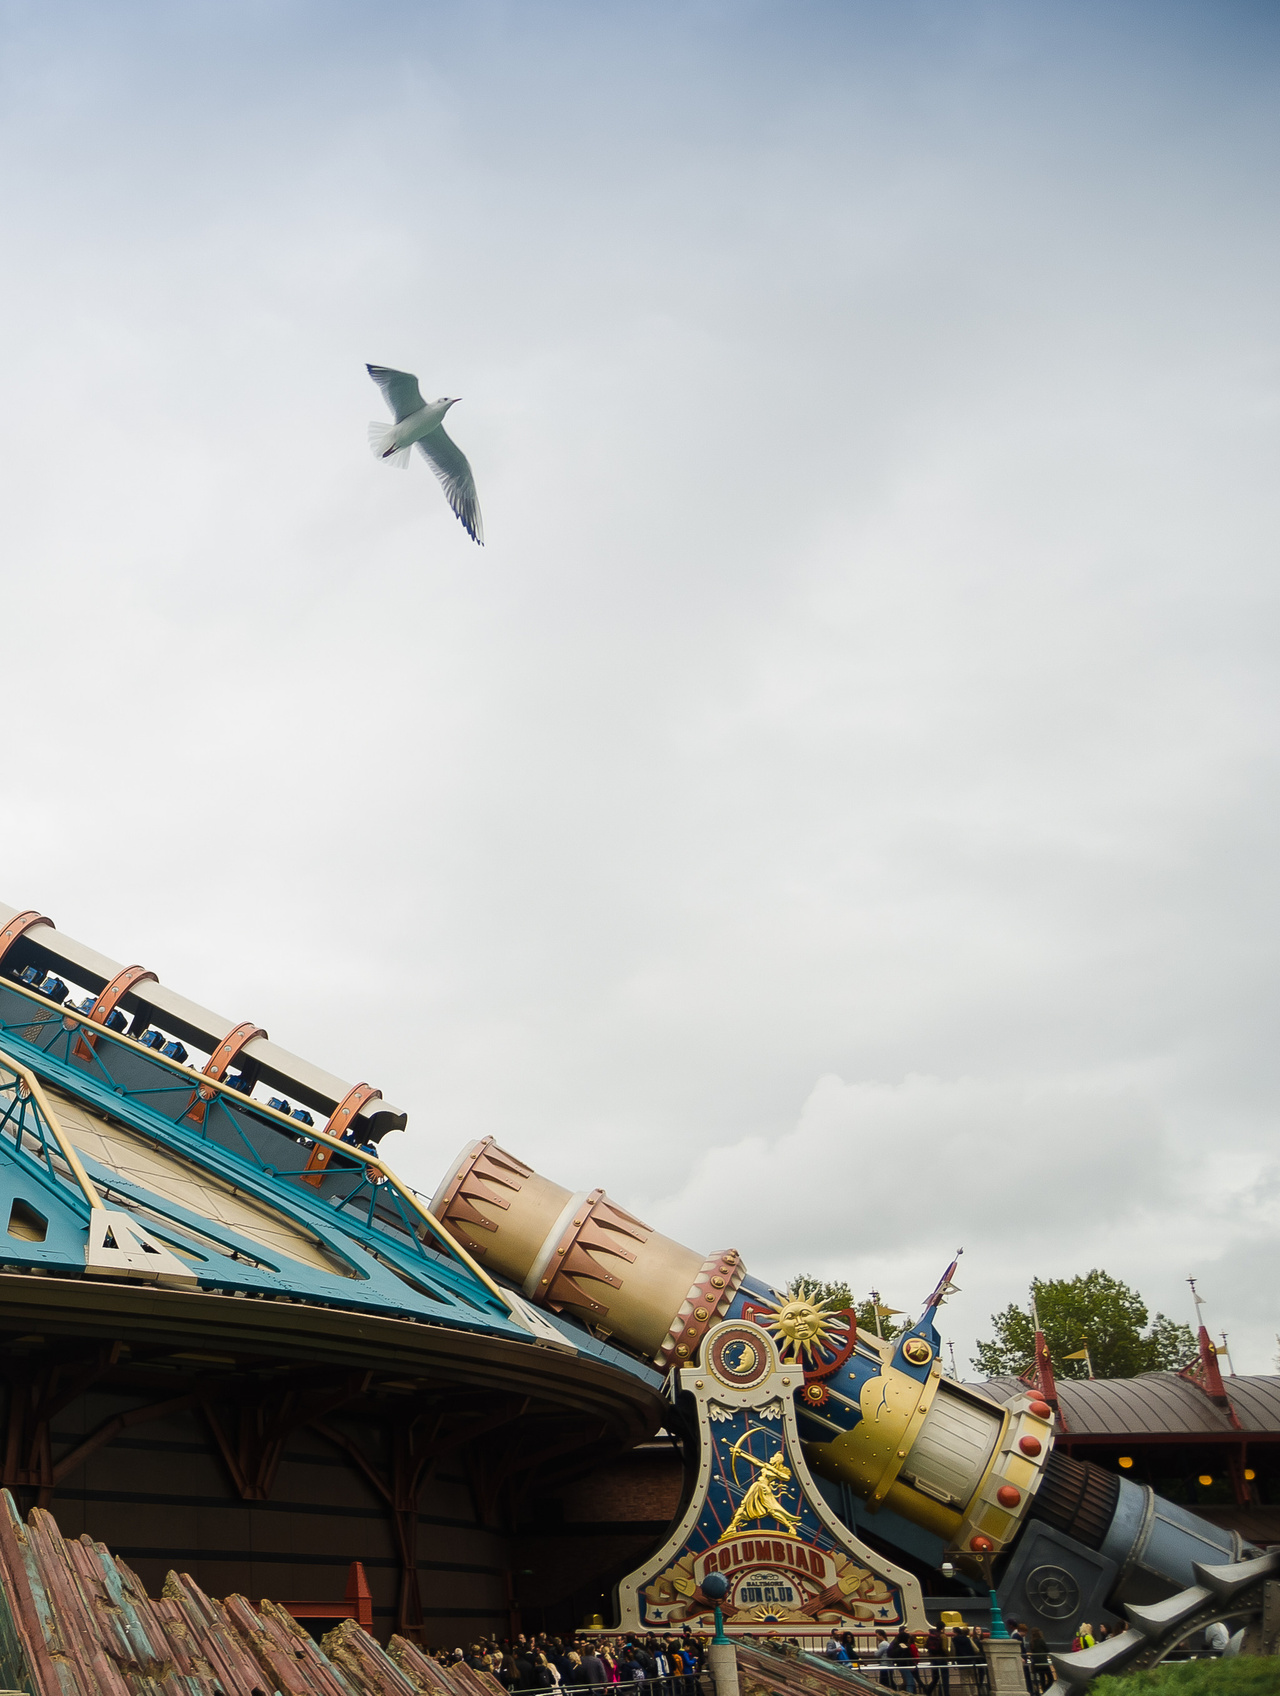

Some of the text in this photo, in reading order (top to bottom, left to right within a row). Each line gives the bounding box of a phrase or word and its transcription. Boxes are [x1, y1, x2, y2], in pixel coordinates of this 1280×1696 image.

[703, 1540, 826, 1579] COLUMBIAD
[740, 1586, 794, 1603] GUN CLUB
